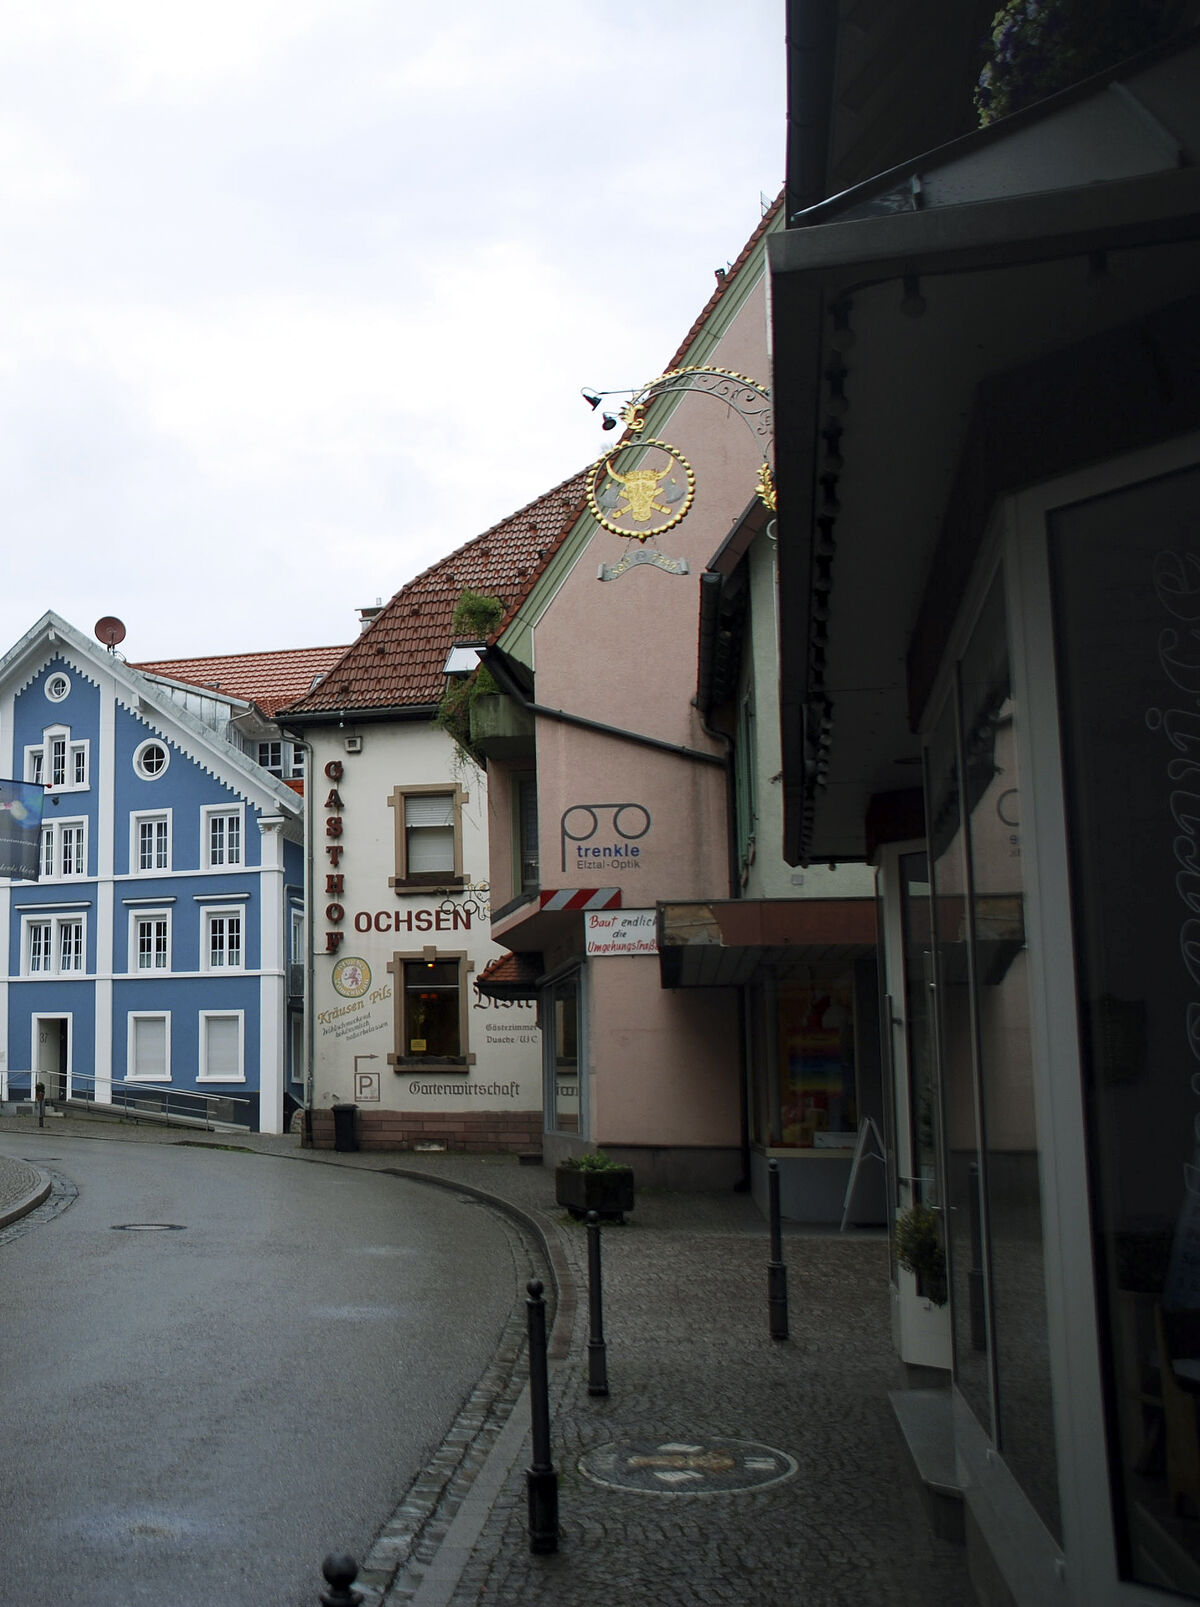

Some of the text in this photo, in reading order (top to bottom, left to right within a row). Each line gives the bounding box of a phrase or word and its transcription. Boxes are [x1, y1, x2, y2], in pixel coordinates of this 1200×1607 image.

[324, 760, 345, 953] GASTHOF
[576, 844, 640, 858] trenkle
[354, 908, 472, 933] OCHSEN
[589, 914, 618, 929] Baut
[612, 929, 627, 938] die
[317, 984, 392, 1025] Kräusen Pils
[359, 1075, 373, 1095] P
[409, 1080, 521, 1098] Gartenwirtschaft
